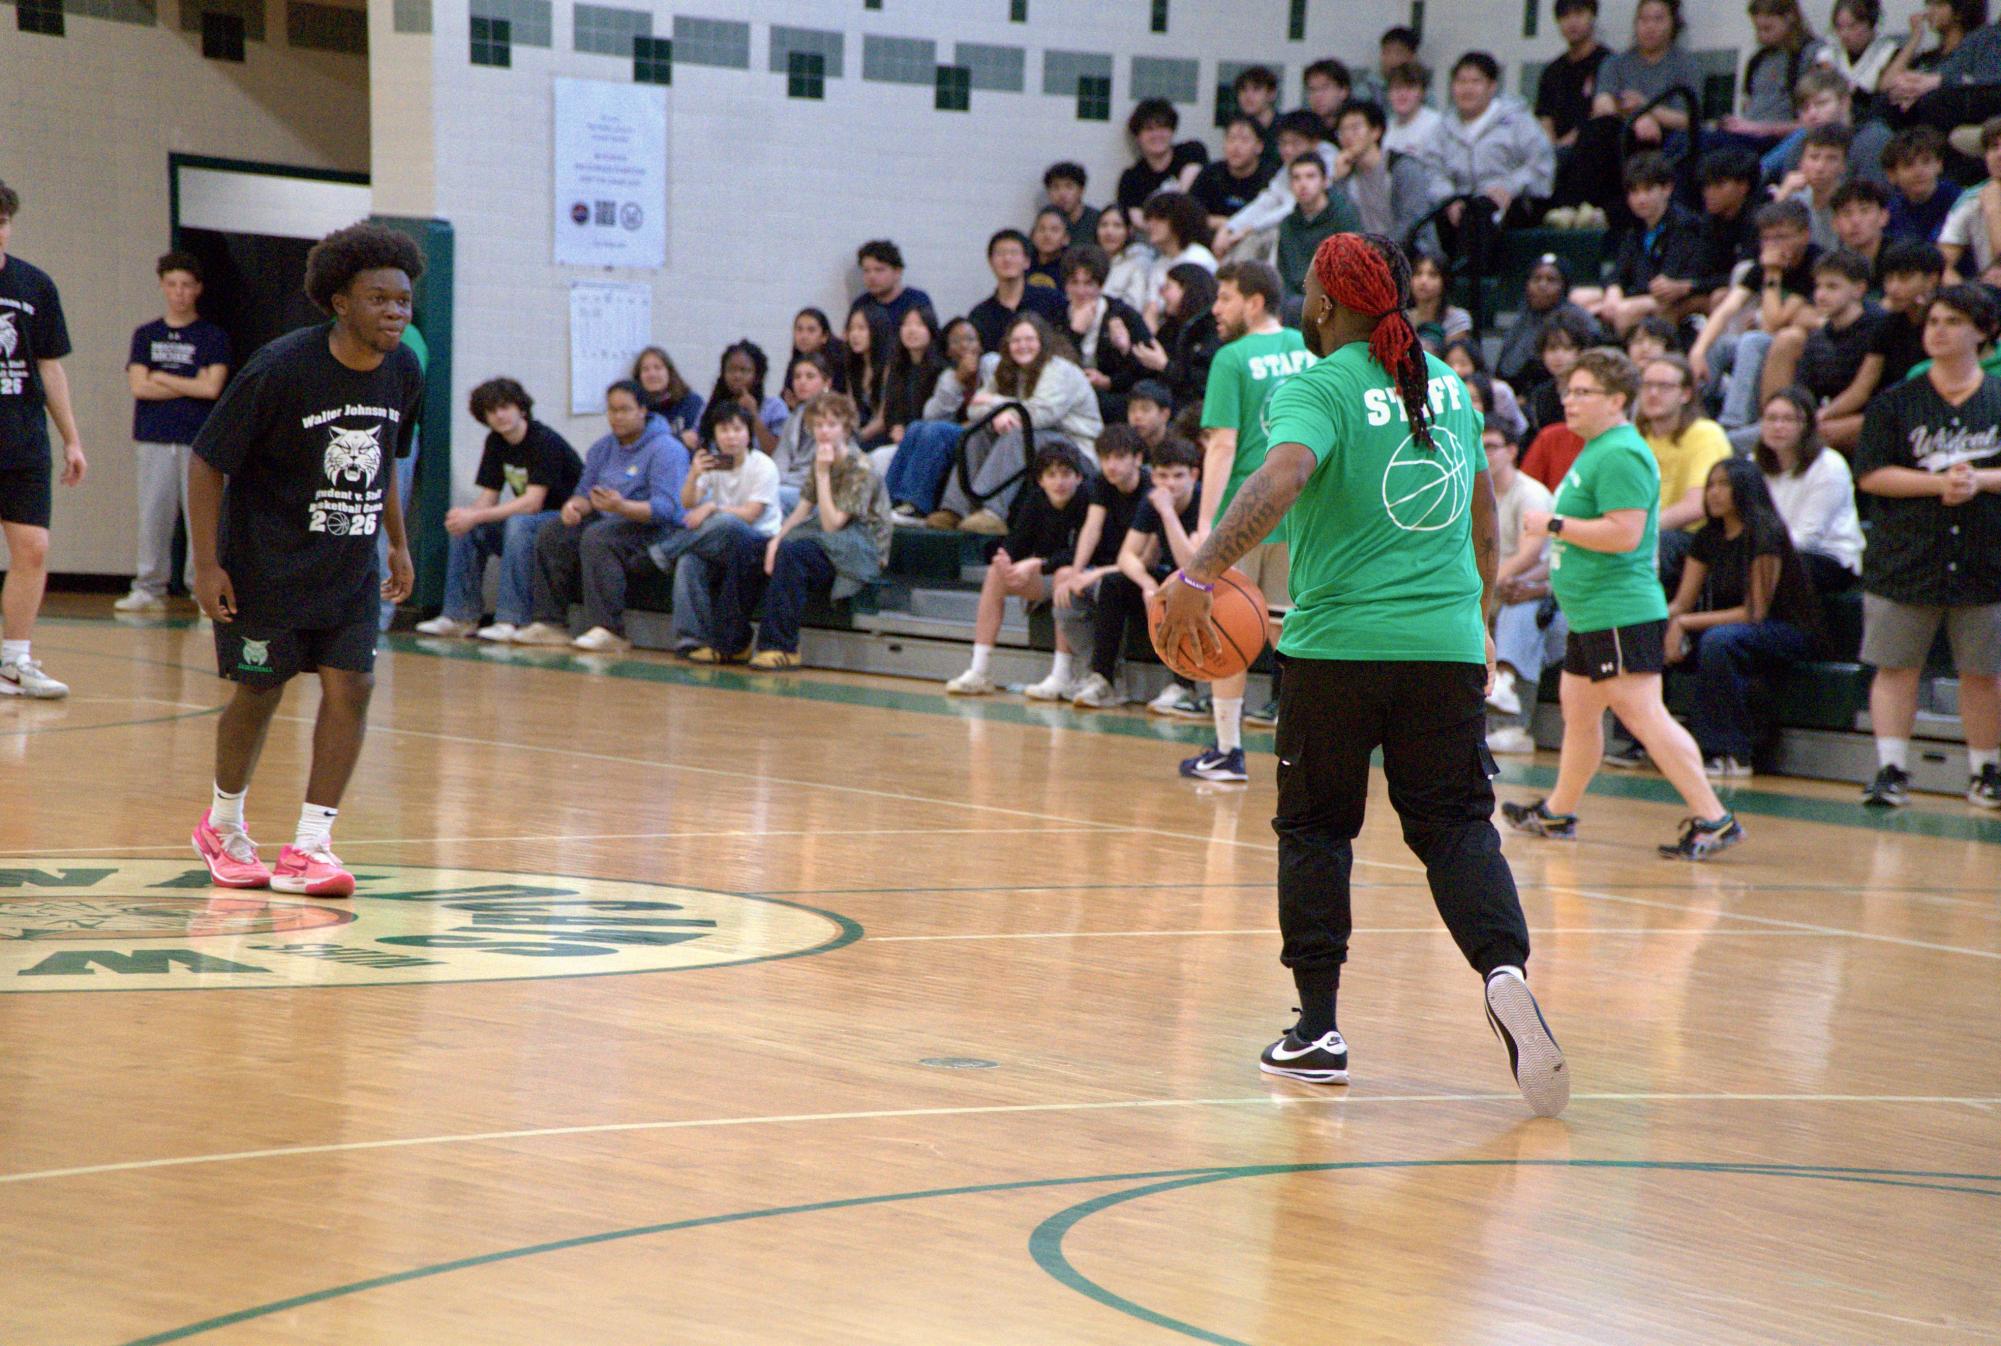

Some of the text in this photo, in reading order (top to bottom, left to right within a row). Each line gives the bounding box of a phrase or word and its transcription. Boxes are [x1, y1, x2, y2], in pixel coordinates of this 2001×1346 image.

[1363, 375, 1462, 427] STFF
[302, 408, 342, 429] Walter
[308, 500, 361, 513] Bsketball
